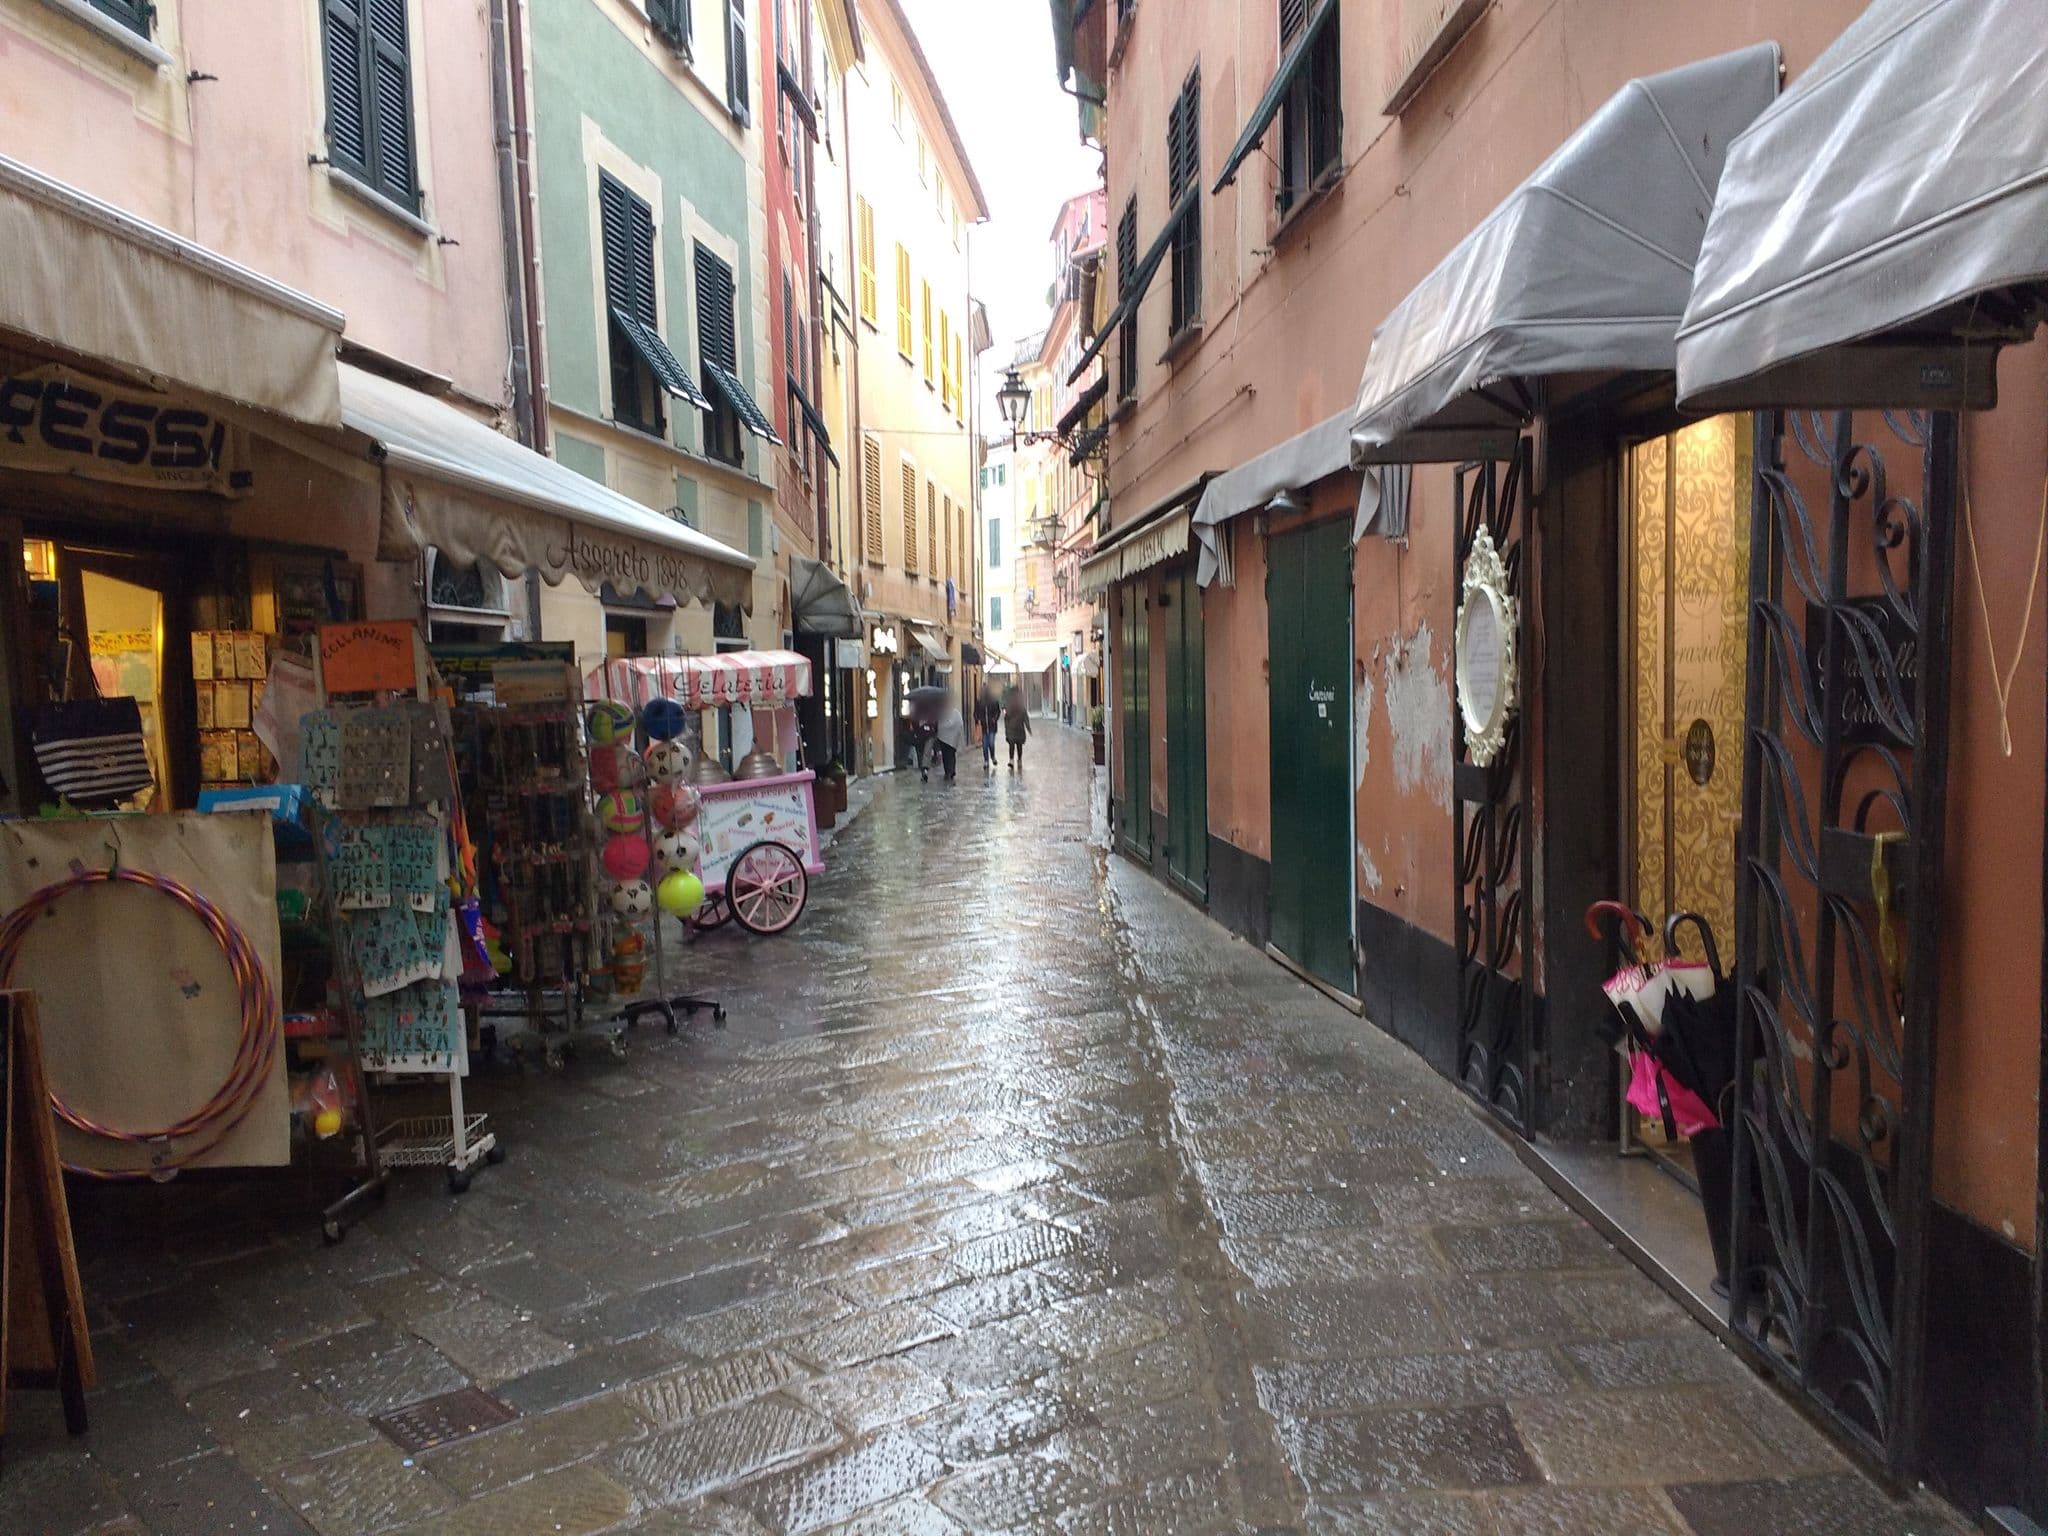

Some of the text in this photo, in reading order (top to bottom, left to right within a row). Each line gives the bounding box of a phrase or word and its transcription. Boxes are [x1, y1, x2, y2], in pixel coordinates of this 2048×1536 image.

[546, 520, 688, 591] Assereto 1898
[673, 669, 783, 697] Gelateria
